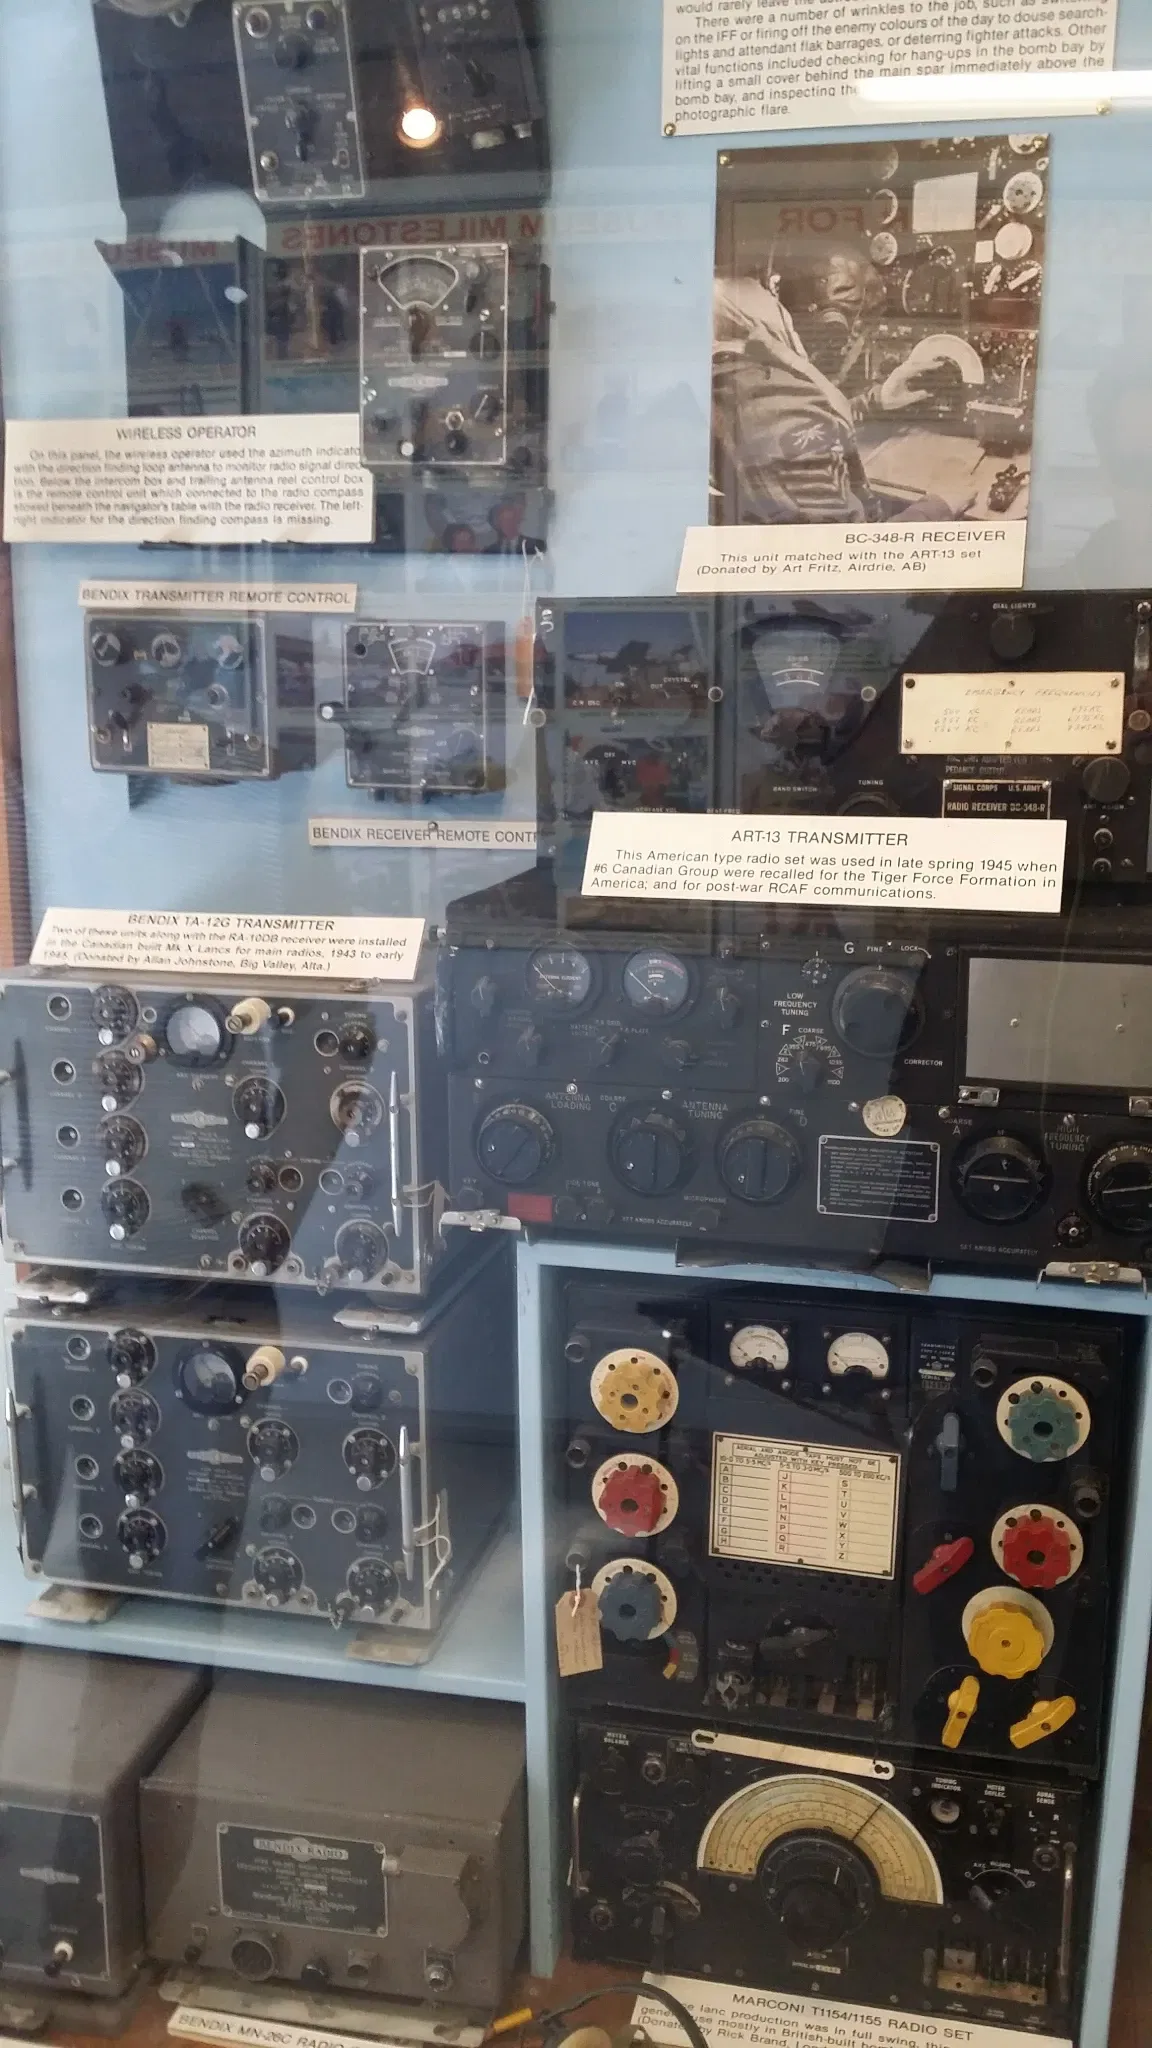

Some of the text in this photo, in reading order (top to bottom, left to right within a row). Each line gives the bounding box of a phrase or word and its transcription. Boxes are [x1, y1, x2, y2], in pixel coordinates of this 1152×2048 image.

[696, 2, 948, 28] There were number wrinkles the
[694, 11, 1054, 43] the firing off the enemy colours the day douse
[676, 23, 1107, 62] lights attendant deterring fighter Other
[705, 41, 1056, 74] functions included checking hang-ups bomb
[676, 56, 1077, 91] lifting small cover behind immediately above
[675, 95, 709, 105] bomb
[675, 107, 756, 122] photographic
[116, 426, 256, 440] WIRELESS OPERATOR
[270, 461, 331, 473] radio signal
[846, 530, 1006, 544] BC-348-R RECEIVER
[721, 549, 981, 562] This unit matched with the ART-13 set
[697, 561, 926, 575] (Donated by Art Fritz, Airdrie, AB)
[82, 589, 351, 603] BENDIX TRANSMITTER REMOTE CONTROL
[952, 784, 1041, 792] SIGNAL CORPS ARMY
[947, 802, 1007, 812] RADIO RECEIVER
[313, 827, 536, 843] BENDIX RECEIVER REMOTE CONT
[731, 830, 908, 846] ART-13 TRANSMITTER
[616, 850, 1057, 873] This American type radio set was used in late spring 1945 when
[594, 863, 1056, 887] #6 Canadian Group were recalled for the Tiger Force Formation in
[591, 877, 936, 900] America; and for post-war RCAF communications.
[128, 914, 335, 931] BENDIX TA-12G TRANSMITTER
[209, 932, 407, 947] the receiver were installed
[198, 945, 403, 962] Lancs for main radios, 1943 early
[844, 942, 854, 954] G
[144, 954, 330, 972] Allan Johnstone, Big Valley, Alta.)
[782, 1024, 791, 1035] F
[551, 1102, 591, 1111] LOADING
[683, 1101, 729, 1111] ANTENNA
[688, 1110, 723, 1119] TUNING
[953, 1125, 961, 1135] A
[733, 1994, 973, 2041] MARCONI T1154/1155 RADIO SET
[178, 2015, 231, 2033] BENDIX
[296, 2037, 344, 2048] RADIO
[700, 2004, 725, 2016] lanc
[731, 2010, 798, 2028] production
[805, 2024, 829, 2033] was
[835, 2027, 845, 2035] in
[852, 2029, 872, 2040] full
[878, 2035, 920, 2048] swing,
[718, 2018, 760, 2034] mostly
[765, 2025, 776, 2035] in
[782, 2028, 856, 2048] British-built
[717, 2028, 744, 2040] Rick
